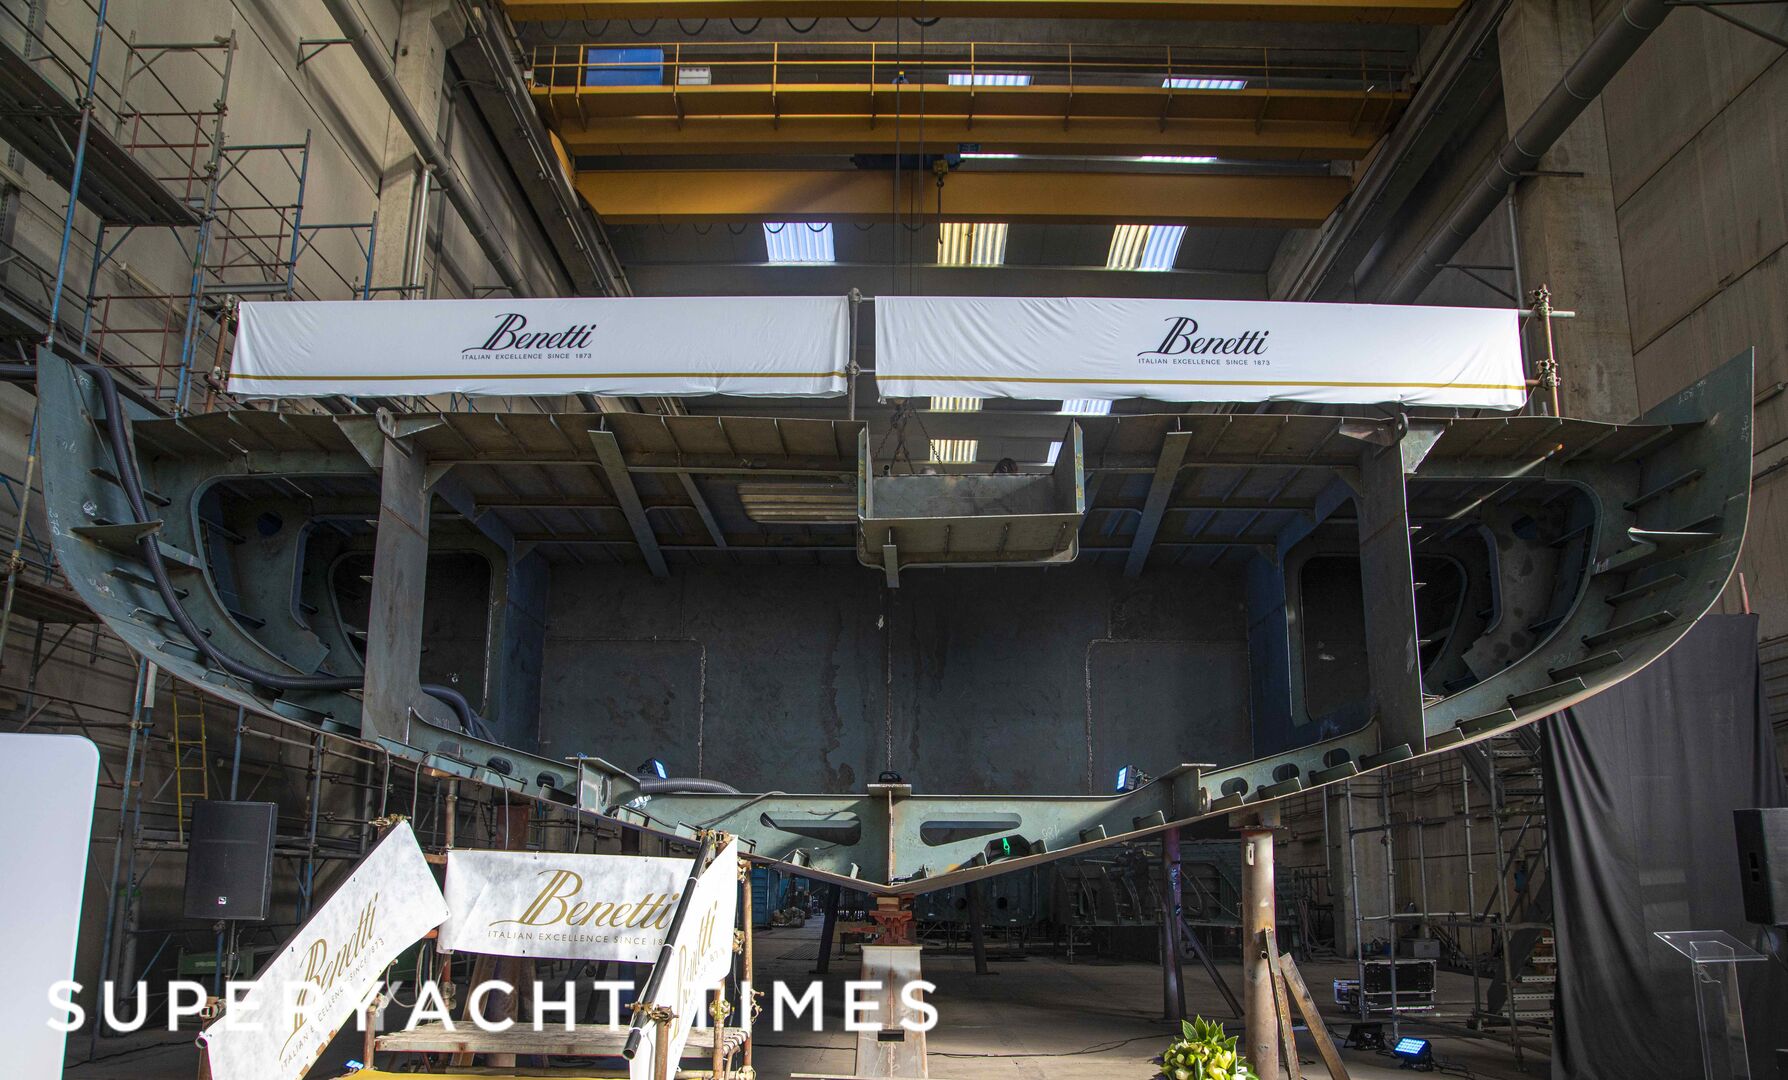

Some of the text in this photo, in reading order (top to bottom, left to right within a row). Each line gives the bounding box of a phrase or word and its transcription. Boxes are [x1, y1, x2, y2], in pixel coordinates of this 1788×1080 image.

[461, 313, 597, 353] Benetti
[1137, 316, 1270, 356] Benetti
[488, 869, 680, 930] Benetti
[488, 931, 533, 940] ITALIAN
[538, 932, 609, 943] EXCELLENCE
[613, 936, 647, 945] SINCE
[281, 1033, 309, 1073] ITALIAN
